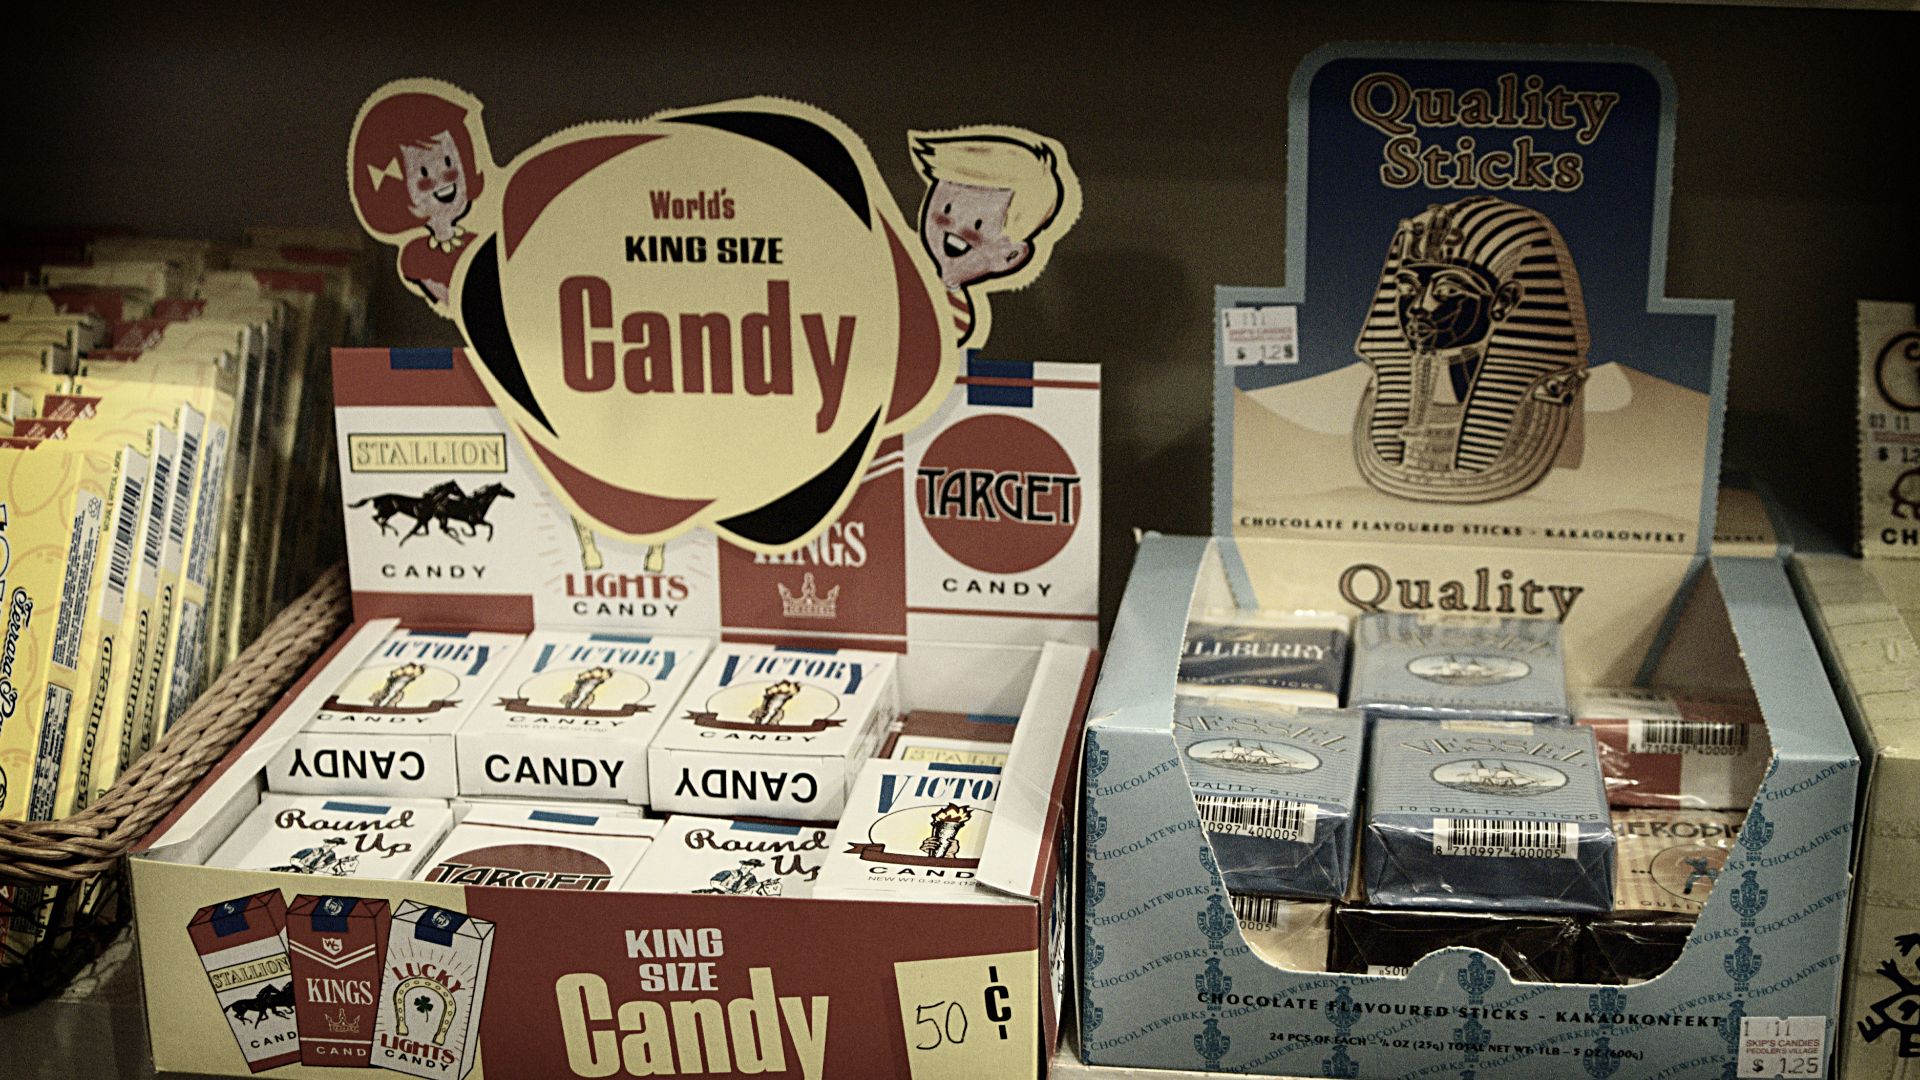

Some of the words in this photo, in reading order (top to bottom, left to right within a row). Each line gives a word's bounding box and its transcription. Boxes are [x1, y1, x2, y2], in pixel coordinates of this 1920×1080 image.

[1351, 72, 1620, 144] Quality
[1381, 135, 1584, 191] Sticks
[650, 187, 735, 220] World's
[625, 235, 707, 264] KING
[717, 237, 783, 264] SIZE
[559, 275, 857, 433] Candy
[356, 441, 502, 467] STALLION
[917, 467, 1081, 524] TARGET
[1240, 516, 1343, 530] CHOCOLATE
[382, 563, 487, 579] CANDY
[564, 572, 689, 600] LIGHTS
[943, 577, 1053, 597] CANDY
[1338, 563, 1584, 623] Quality
[573, 601, 679, 618] CANDY
[533, 643, 692, 681] VICTORY
[719, 655, 880, 695] VICTORY
[317, 714, 429, 724] CANDY
[509, 715, 625, 728] CANDY
[700, 731, 816, 743] CANDY
[288, 749, 425, 781] CANDY
[485, 754, 624, 788] CANDY
[674, 768, 818, 803] CANDY
[878, 774, 1000, 814] VICTO
[275, 808, 415, 832] Round
[1429, 806, 1516, 817] QUALITY
[354, 832, 412, 859] Up
[684, 828, 830, 853] Round
[1248, 824, 1299, 841] 400005
[1435, 845, 1443, 856] 8
[1452, 845, 1502, 858] 710997
[1510, 847, 1561, 859] 400005
[436, 862, 614, 892] TARGET
[1092, 885, 1210, 927] CHOCOLATEWORKS
[625, 927, 724, 958] KING
[212, 956, 291, 990] STALLION
[391, 962, 465, 995] LUCKY
[639, 962, 719, 992] SIZE
[1091, 947, 1208, 989] CHOCOLATEWORKS
[305, 977, 374, 1006] KINGS
[555, 967, 829, 1080] Candy
[1197, 992, 1319, 1010] CHOCOLATE
[1328, 1002, 1449, 1017] FLAVOURED
[1458, 1007, 1529, 1021] STICKS
[1556, 1011, 1721, 1027] KAKAOKONFEKT
[250, 1031, 297, 1049] CAND
[915, 1001, 968, 1050] 50
[1090, 1010, 1206, 1051] CHOCOLATEWORKS
[316, 1046, 367, 1057] CAND
[380, 1033, 456, 1064] LIGHTS
[1269, 1033, 1284, 1041] 24
[1288, 1034, 1311, 1043] PCS
[1314, 1035, 1331, 1044] OF
[1334, 1036, 1366, 1046] EACH
[1393, 1040, 1409, 1048] OZ
[1448, 1043, 1485, 1052] TOTAL
[1488, 1044, 1510, 1053] NET
[1584, 1049, 1601, 1057] OZ
[1745, 1039, 1776, 1048] SKIP'S
[1777, 1039, 1820, 1047] CANDIES
[384, 1050, 450, 1072] CANDY
[1752, 1058, 1765, 1073] $
[1779, 1057, 1819, 1075] 1.25
